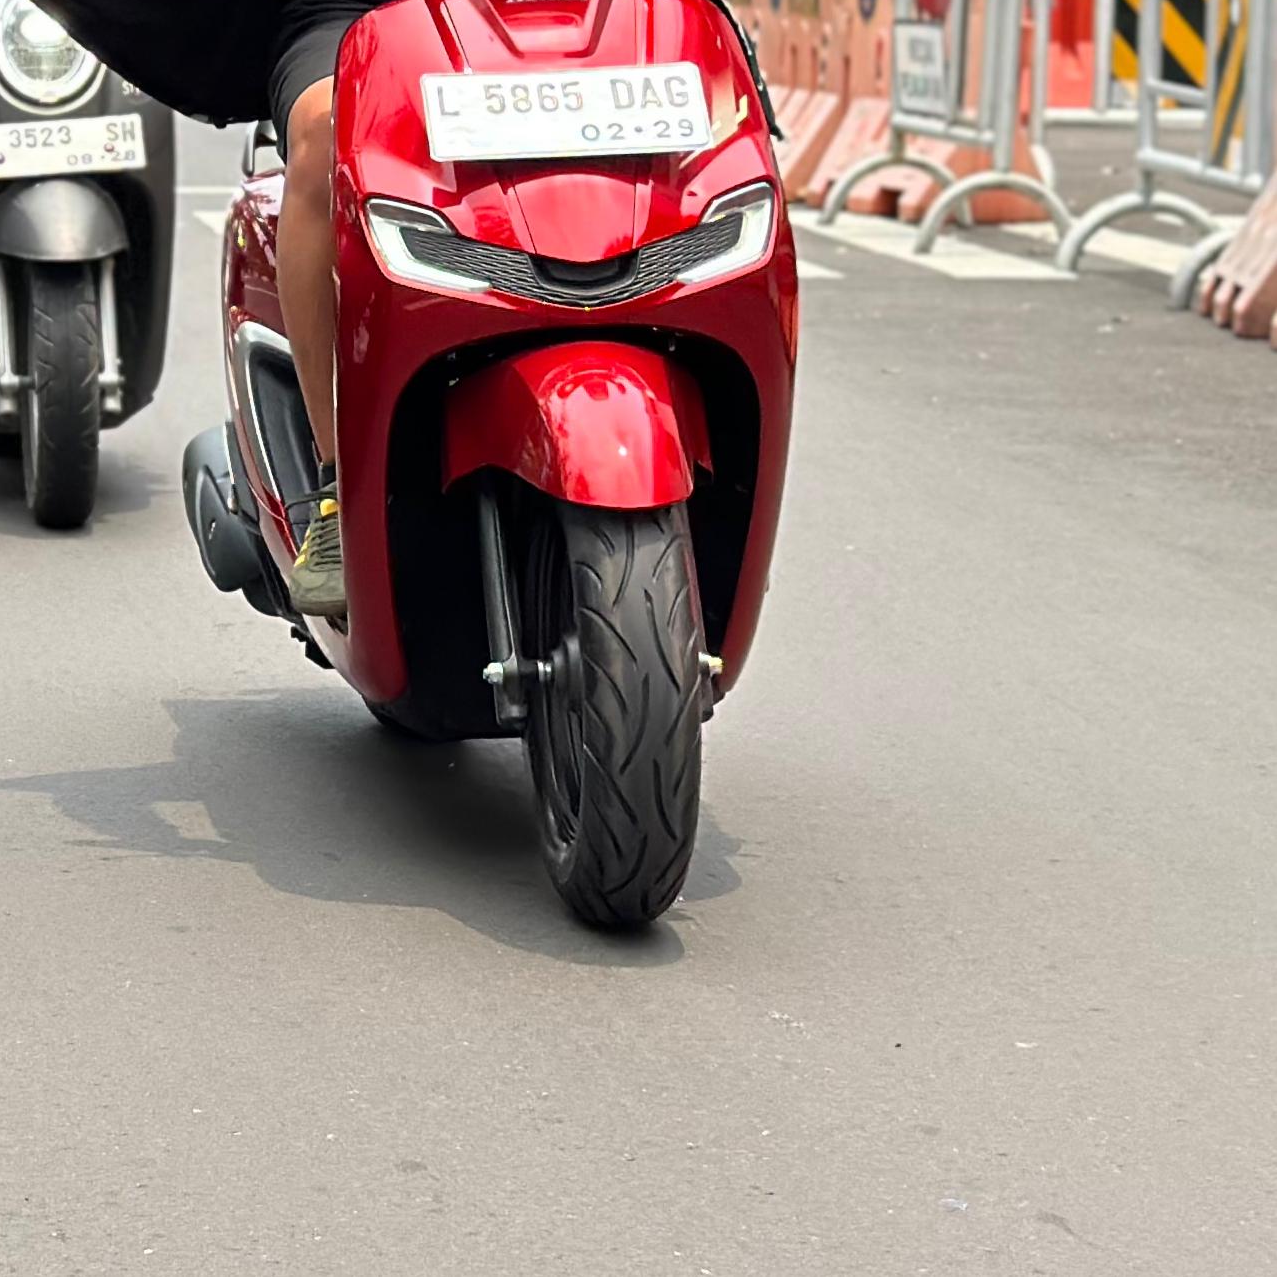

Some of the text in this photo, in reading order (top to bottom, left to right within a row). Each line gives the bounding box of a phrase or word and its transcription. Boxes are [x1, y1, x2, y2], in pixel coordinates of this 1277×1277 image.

[437, 75, 690, 117] L 5865 DAG
[9, 125, 72, 149] 3523
